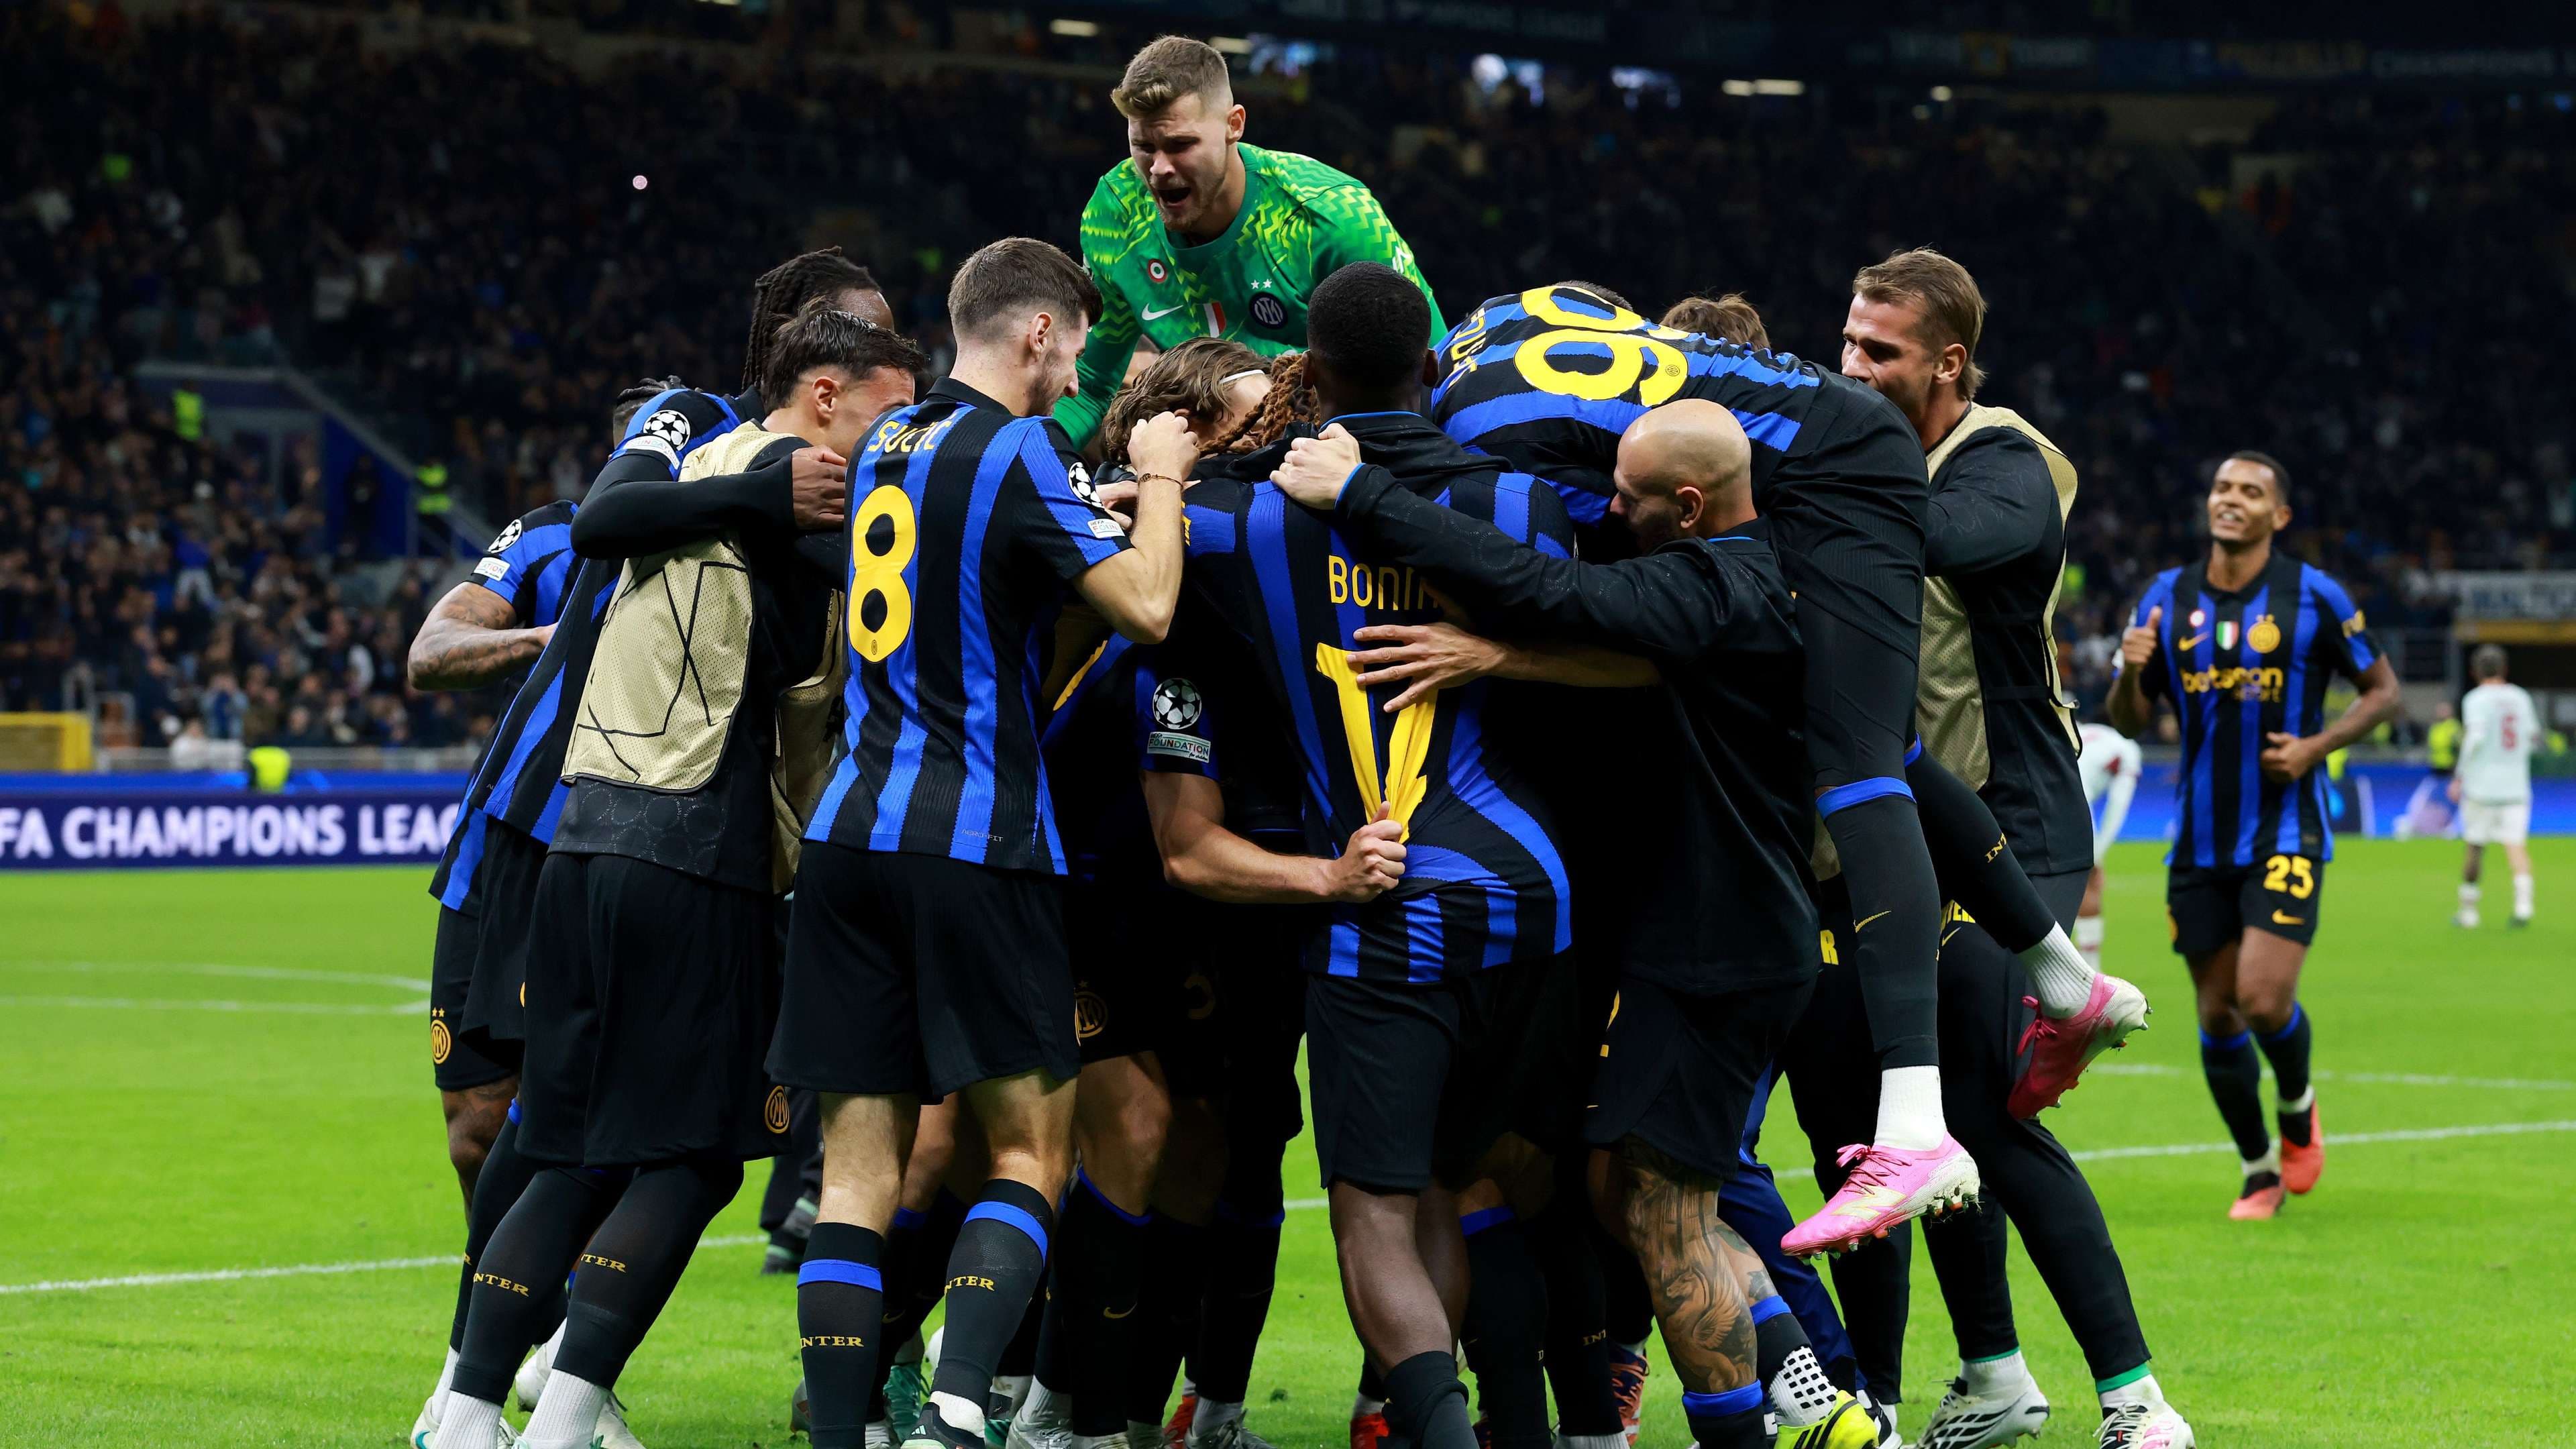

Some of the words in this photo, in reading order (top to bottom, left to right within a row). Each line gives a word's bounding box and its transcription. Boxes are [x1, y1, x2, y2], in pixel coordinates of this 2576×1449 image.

[848, 484, 917, 663] 8
[1148, 739, 1209, 756] FOUNDATION
[61, 805, 346, 859] CHAMPIONS
[2263, 854, 2314, 900] 25
